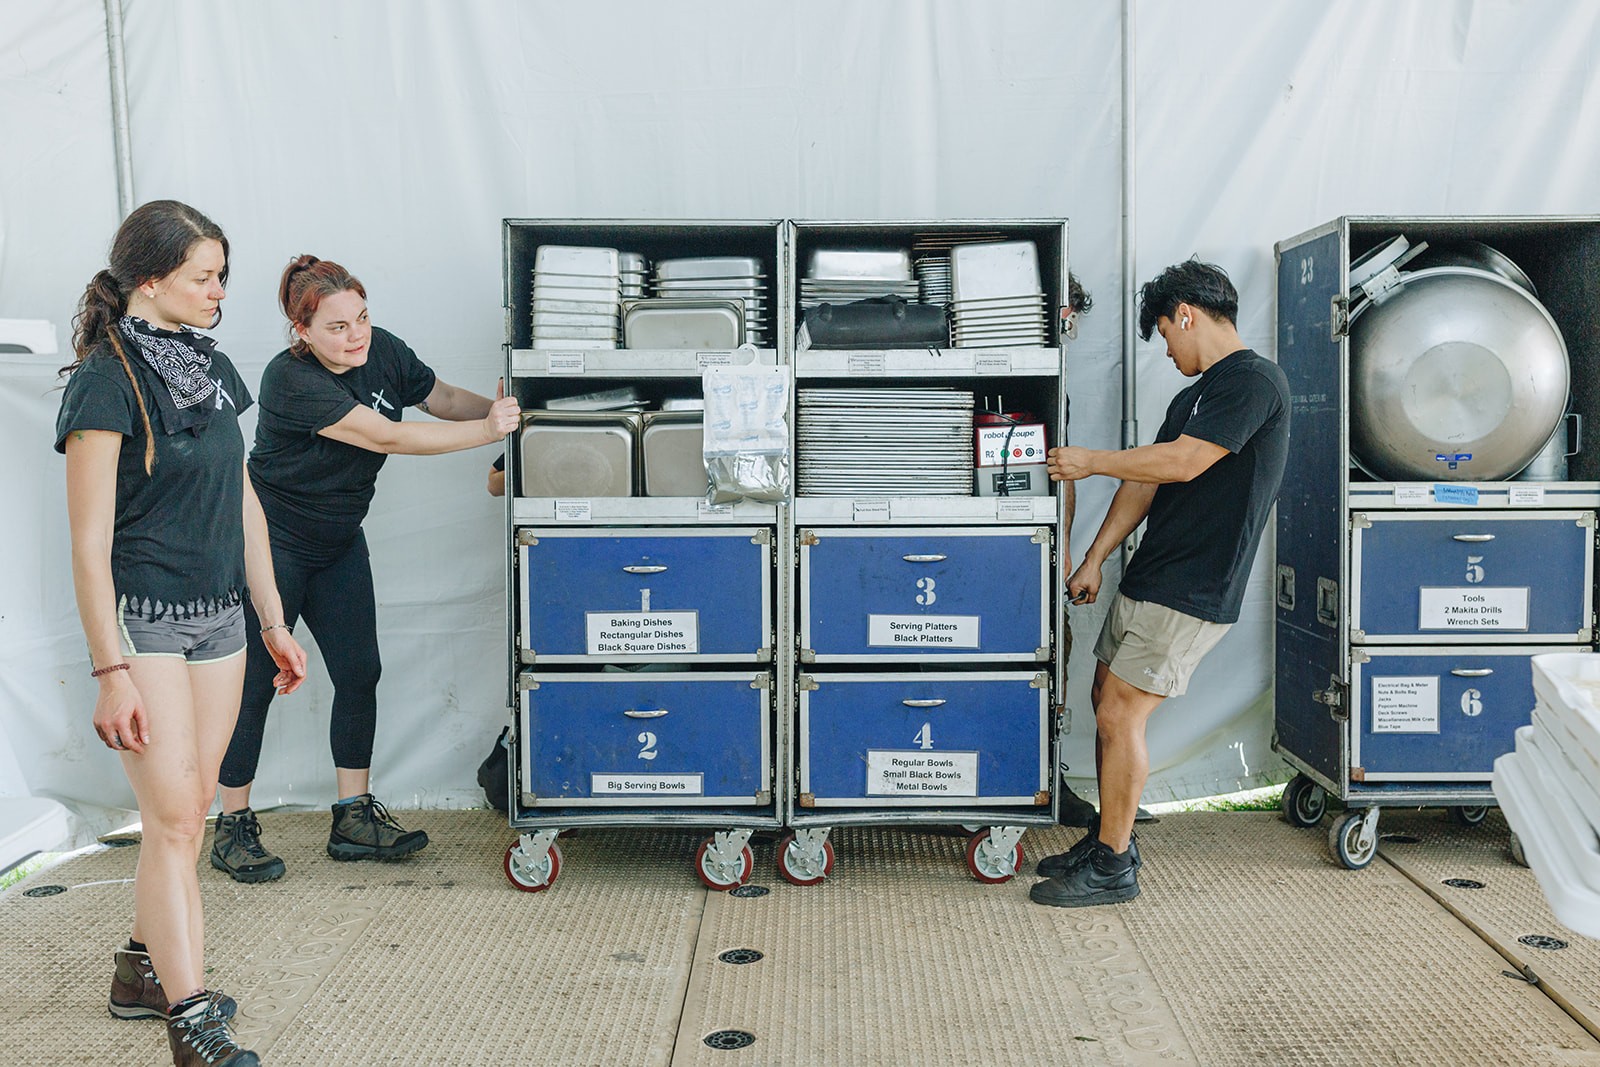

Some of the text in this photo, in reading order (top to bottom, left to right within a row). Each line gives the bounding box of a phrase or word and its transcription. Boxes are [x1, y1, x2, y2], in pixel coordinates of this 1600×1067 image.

[1302, 256, 1313, 284] 23
[1466, 556, 1484, 583] 5
[640, 589, 650, 612] 1
[916, 577, 936, 605] 3
[611, 619, 640, 628] Baking
[890, 622, 922, 631] Serving
[600, 632, 651, 640] Rectangular
[624, 643, 654, 652] Square
[1461, 688, 1482, 716] 6
[638, 732, 657, 760] 2
[913, 722, 934, 749] 4
[892, 759, 953, 768] Regular Bowls
[608, 782, 622, 790] Big
[624, 782, 657, 791] Serving
